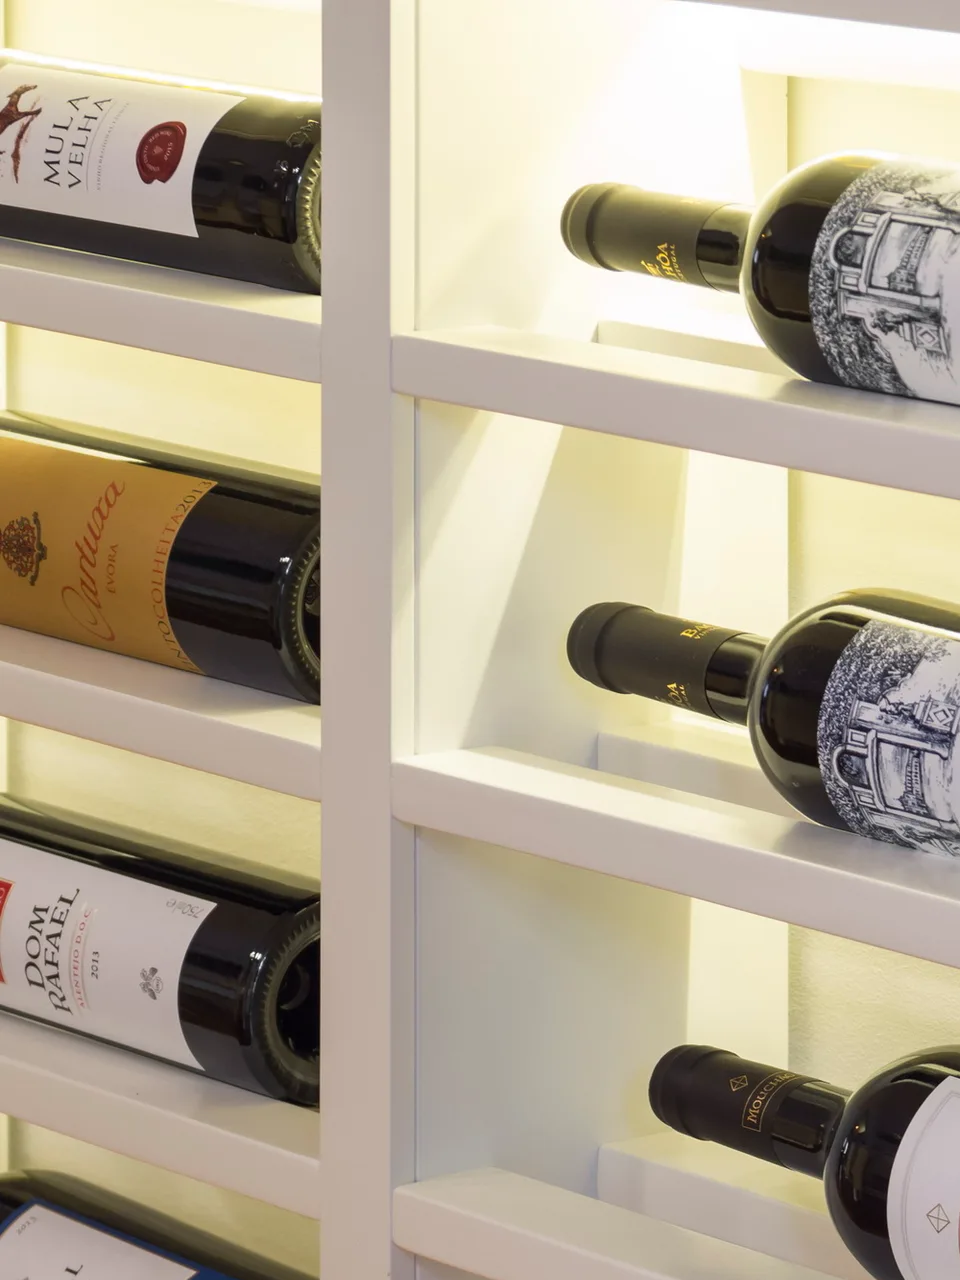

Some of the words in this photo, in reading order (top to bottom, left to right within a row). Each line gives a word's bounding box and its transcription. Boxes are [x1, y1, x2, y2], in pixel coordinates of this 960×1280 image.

[43, 95, 90, 187] MULA
[68, 97, 112, 189] VELHA
[61, 478, 126, 642] Cartuxa
[150, 513, 184, 621] COLHEITA
[178, 480, 213, 513] 2013
[24, 904, 50, 991] DOM
[44, 888, 80, 1016] RAFAEL
[71, 949, 86, 1008] ALENTEJO
[91, 950, 100, 980] 2013
